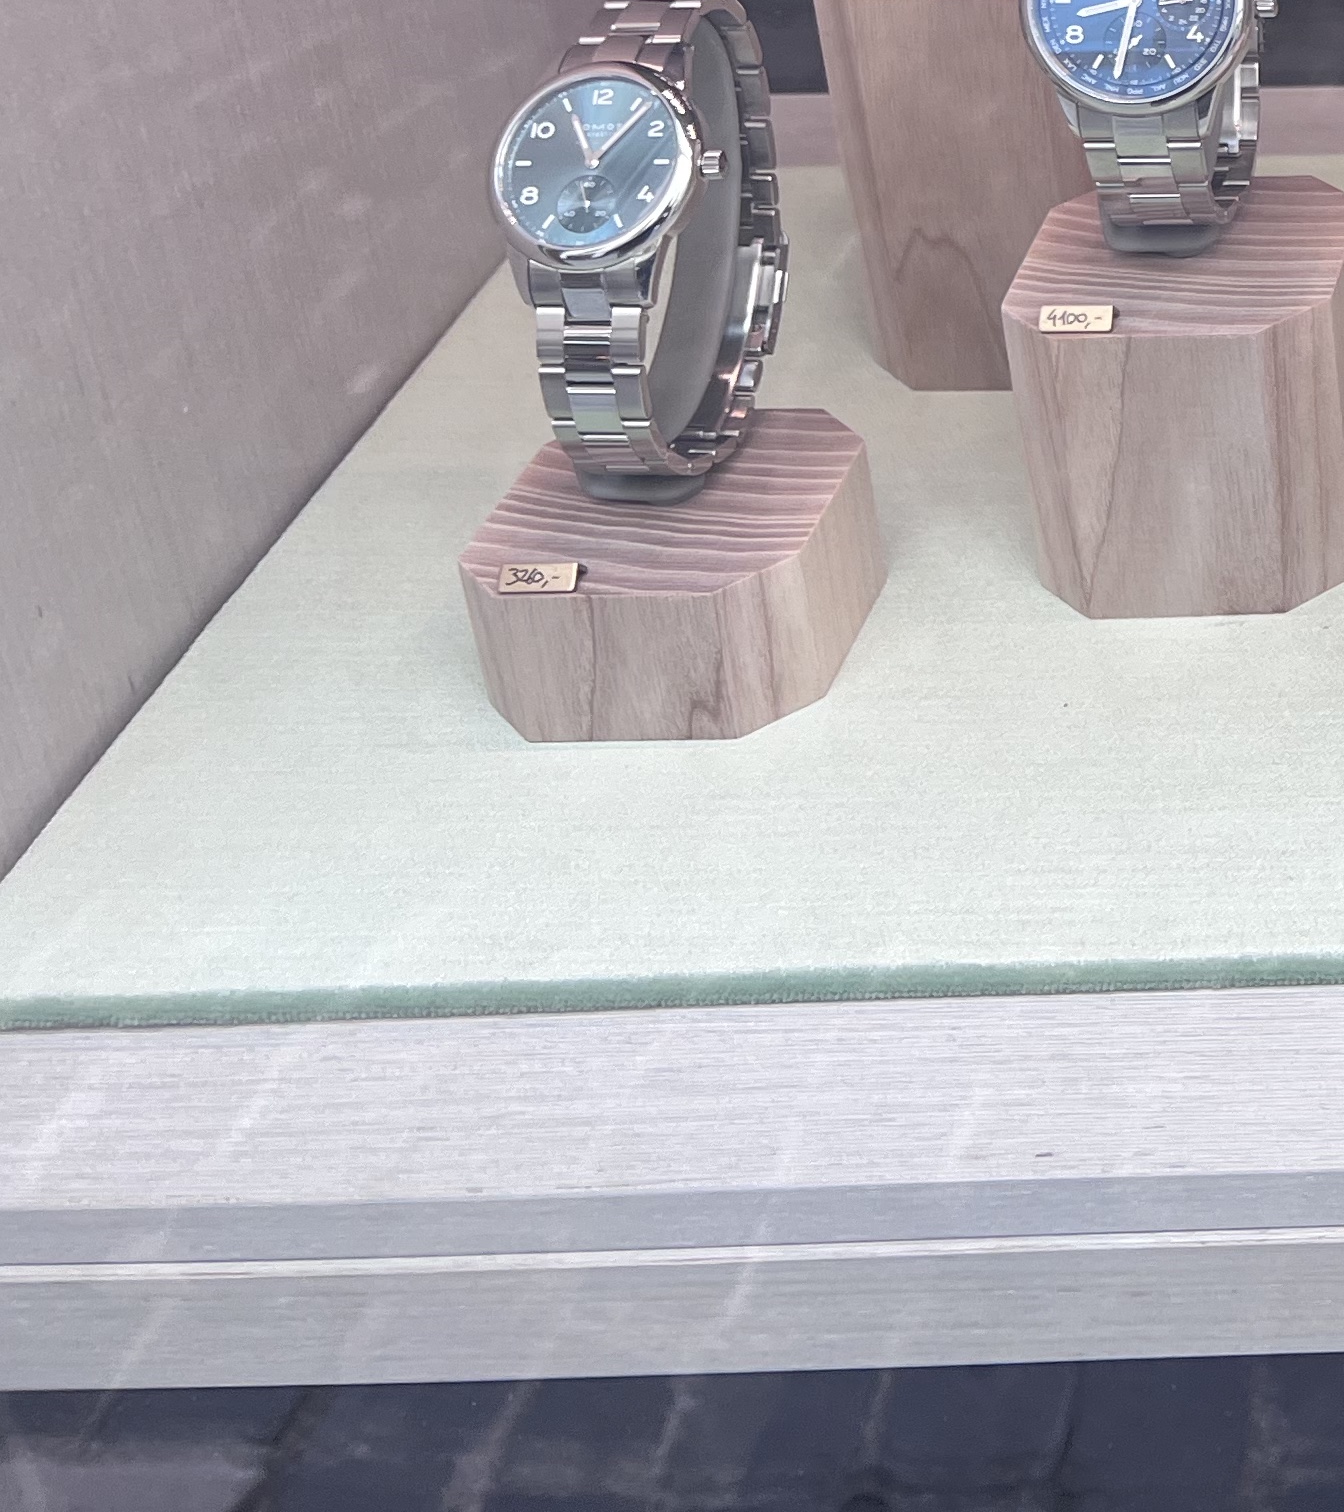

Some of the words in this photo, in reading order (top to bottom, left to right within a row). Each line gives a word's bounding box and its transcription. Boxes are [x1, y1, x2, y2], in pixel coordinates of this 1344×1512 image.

[1065, 24, 1085, 44] 8
[1186, 24, 1205, 43] 4
[591, 89, 614, 105] 12
[530, 122, 555, 139] 10
[647, 120, 665, 138] 2
[519, 186, 539, 205] 8
[636, 185, 654, 203] 4
[1047, 308, 1102, 329] 4100,-
